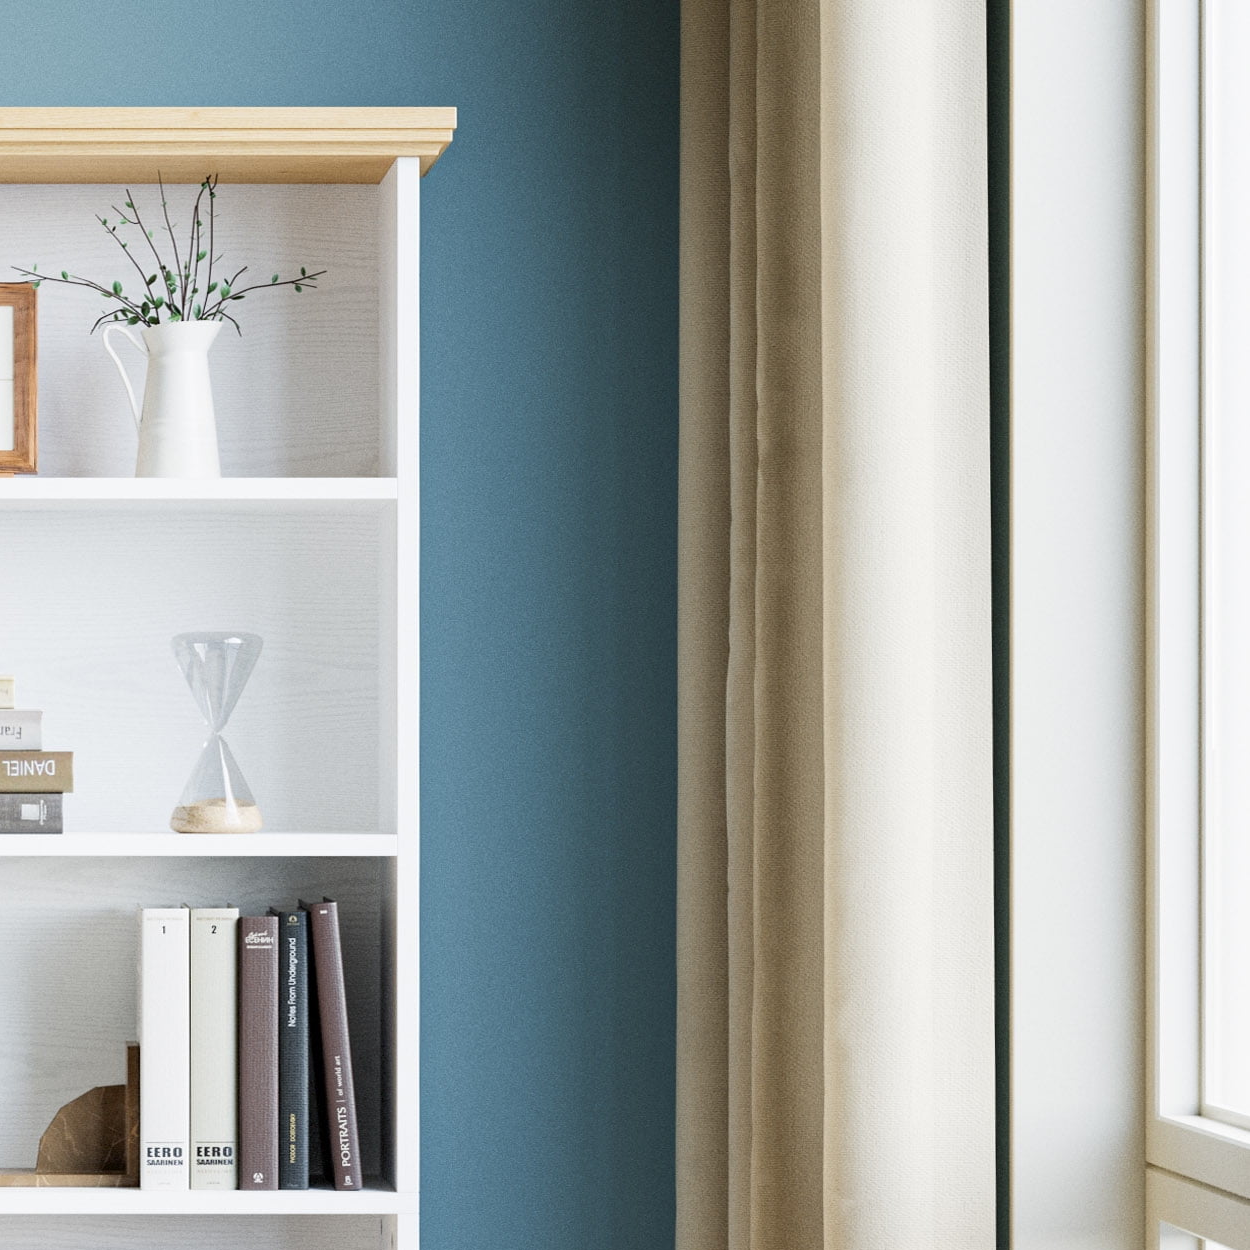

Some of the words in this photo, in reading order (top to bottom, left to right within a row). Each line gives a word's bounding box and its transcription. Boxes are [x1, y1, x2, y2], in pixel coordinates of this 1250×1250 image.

[2, 760, 55, 776] DANIEL
[161, 925, 166, 934] 1
[211, 925, 217, 934] 2
[287, 937, 298, 985] Underground
[287, 1006, 296, 1027] Notes
[337, 1106, 351, 1167] PORTRAITS
[146, 1147, 183, 1158] EERO
[196, 1146, 232, 1157] EERO
